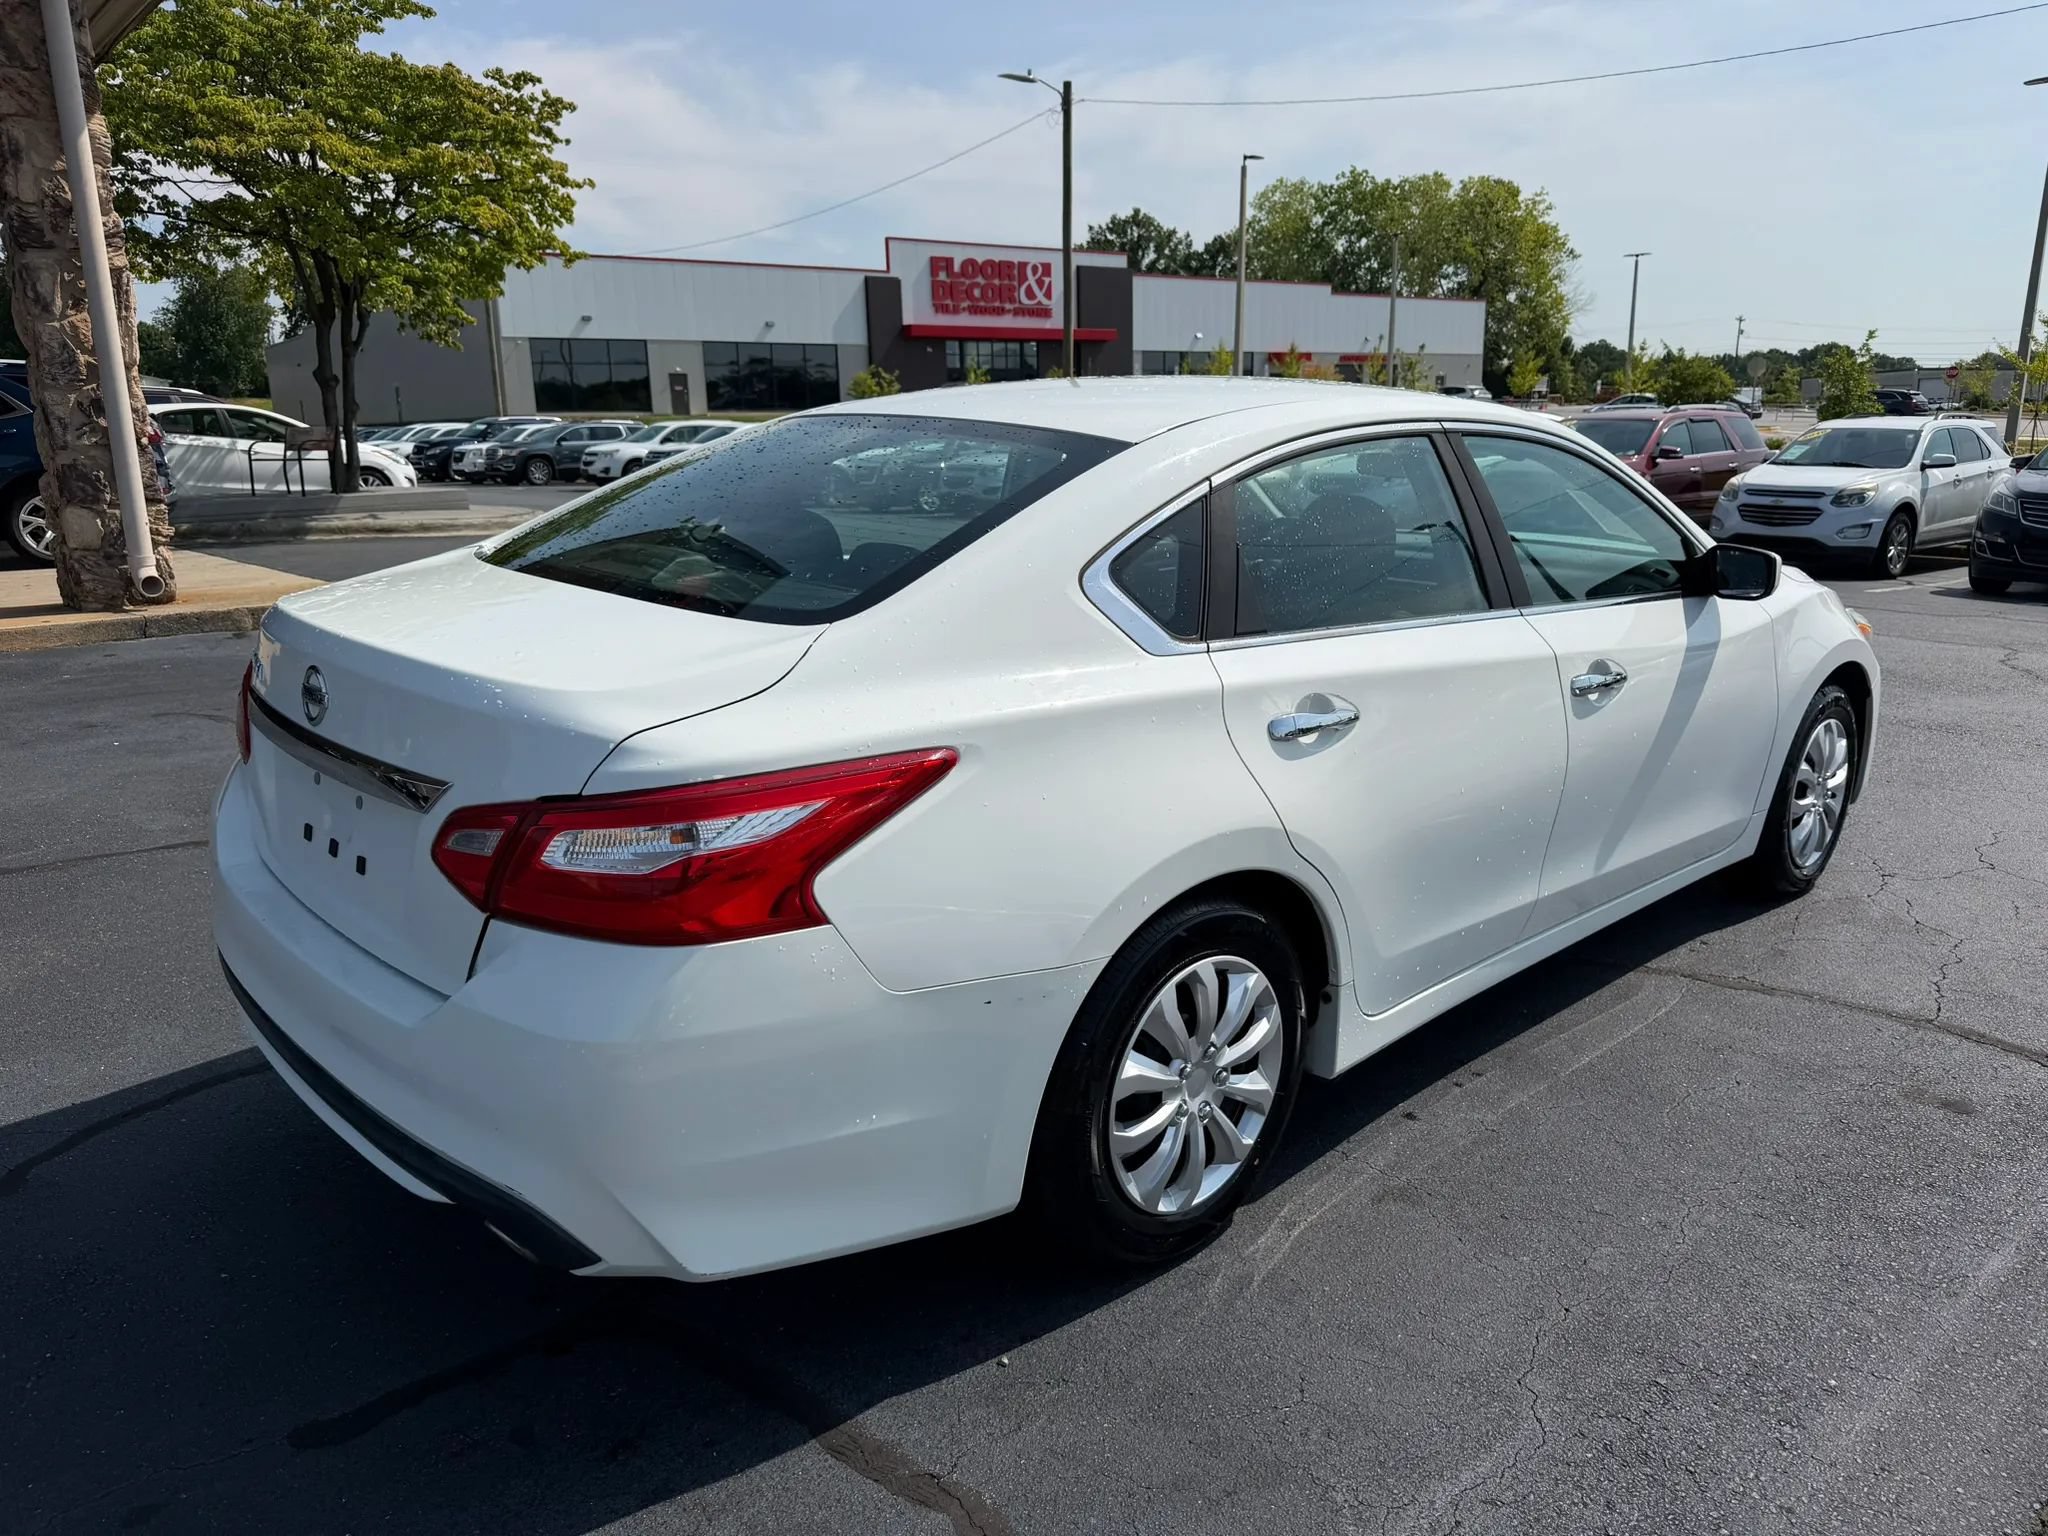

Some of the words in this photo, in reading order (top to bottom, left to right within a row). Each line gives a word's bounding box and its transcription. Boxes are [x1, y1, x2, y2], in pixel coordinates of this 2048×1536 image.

[930, 256, 1017, 281] FLOOR
[1019, 261, 1053, 305] &
[931, 280, 1018, 304] DECOR
[933, 303, 961, 315] TILE
